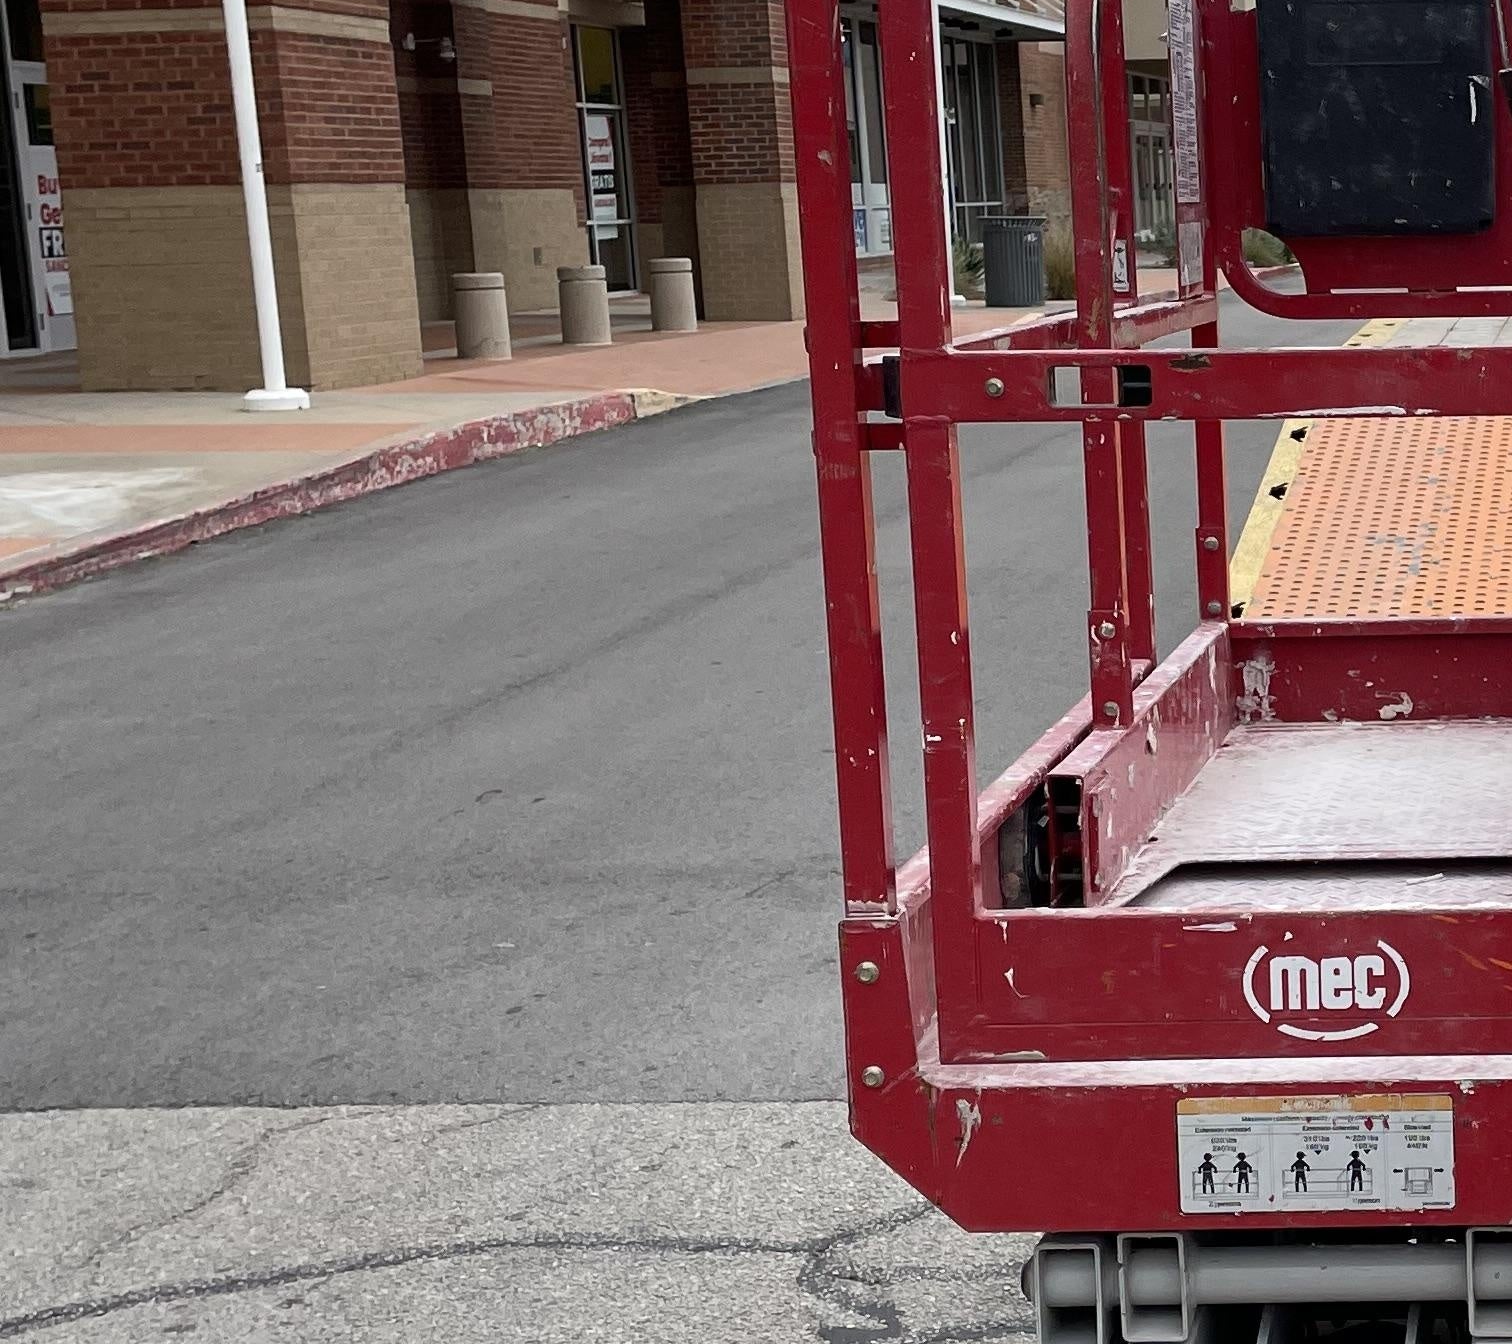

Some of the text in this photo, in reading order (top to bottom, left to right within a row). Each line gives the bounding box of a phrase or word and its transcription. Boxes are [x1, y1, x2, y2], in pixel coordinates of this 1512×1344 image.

[37, 174, 59, 195] Bu
[40, 203, 61, 225] Ge
[42, 229, 64, 256] FR
